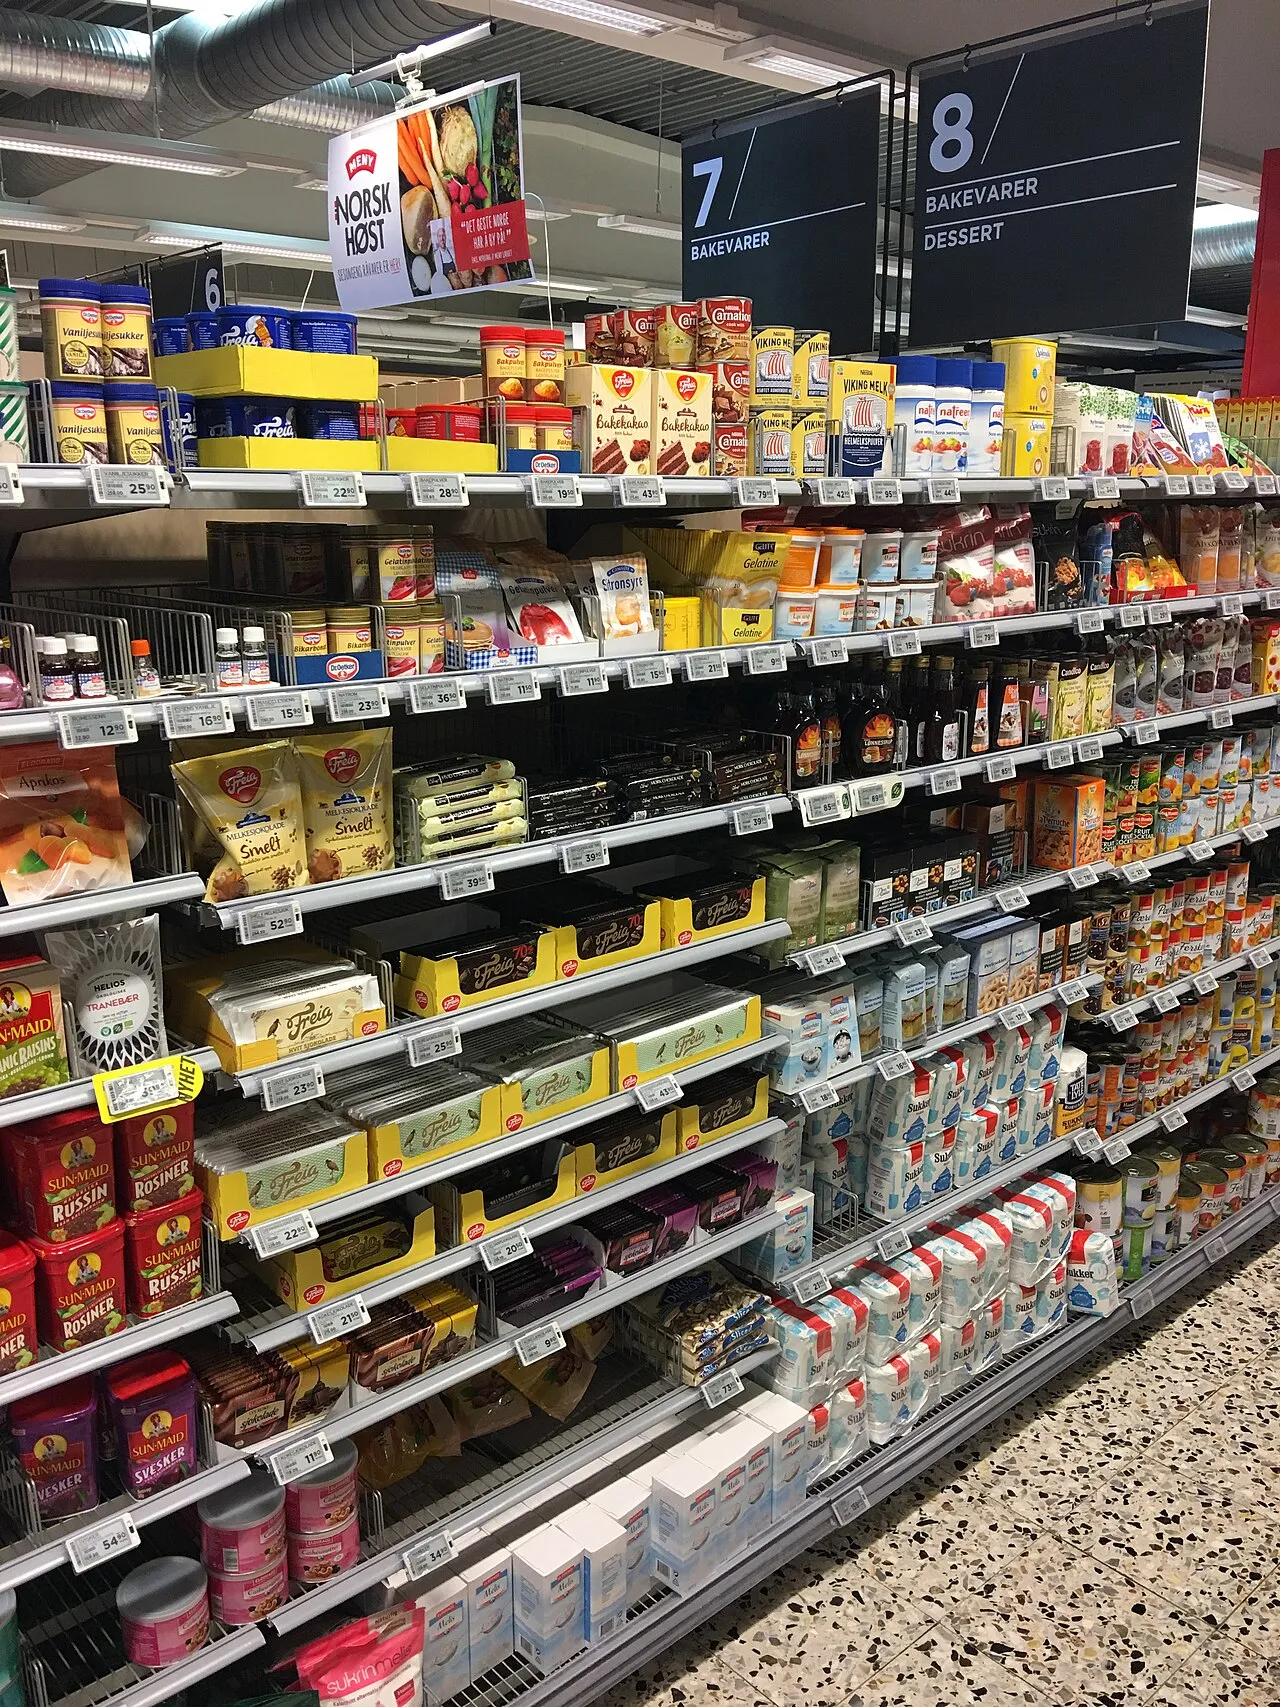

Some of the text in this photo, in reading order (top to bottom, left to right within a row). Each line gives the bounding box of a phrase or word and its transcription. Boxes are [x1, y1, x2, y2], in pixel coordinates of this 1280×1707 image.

[929, 93, 974, 173] 8
[349, 153, 375, 172] MENY
[336, 182, 392, 225] NORSK
[692, 157, 723, 228] 7
[926, 178, 1038, 213] BAKEVARER
[477, 211, 510, 231] BESTE NORGE
[345, 219, 385, 256] HØST
[473, 236, 484, 249] HAR
[691, 232, 770, 260] BAKEVARER
[924, 222, 1005, 252] DESSERT
[205, 268, 220, 311] 6
[755, 338, 782, 350] VIKING
[843, 378, 888, 397] VIKING MELK
[596, 413, 649, 430] Bakekakao
[661, 416, 710, 432] Bakekakao
[743, 558, 779, 569] Gelatine
[733, 627, 763, 638] Gelatine
[328, 754, 358, 774] Freia
[19, 774, 66, 791] Aprikos
[225, 770, 259, 793] Freia
[226, 820, 286, 841] MELKESJOKOLADE
[335, 813, 373, 836] Smelt
[239, 832, 281, 860] Smelt
[707, 894, 739, 925] Freia
[596, 921, 630, 955] Freia
[94, 979, 126, 992] HELIOS
[86, 993, 139, 1012] TRANEBÆR
[286, 1002, 333, 1041] Freia
[18, 1035, 56, 1064] RAISINS
[674, 1027, 706, 1058] Freia
[535, 1072, 571, 1107] Freia
[422, 1112, 462, 1149] Freia
[609, 1136, 642, 1168] Freia
[134, 1159, 189, 1200] ROSINER
[270, 1161, 319, 1200] Freia
[52, 1183, 108, 1223] RUSSIN
[63, 1297, 115, 1340] ROSINER
[239, 1406, 280, 1430] sjokolade
[134, 1446, 185, 1485] SVESKER
